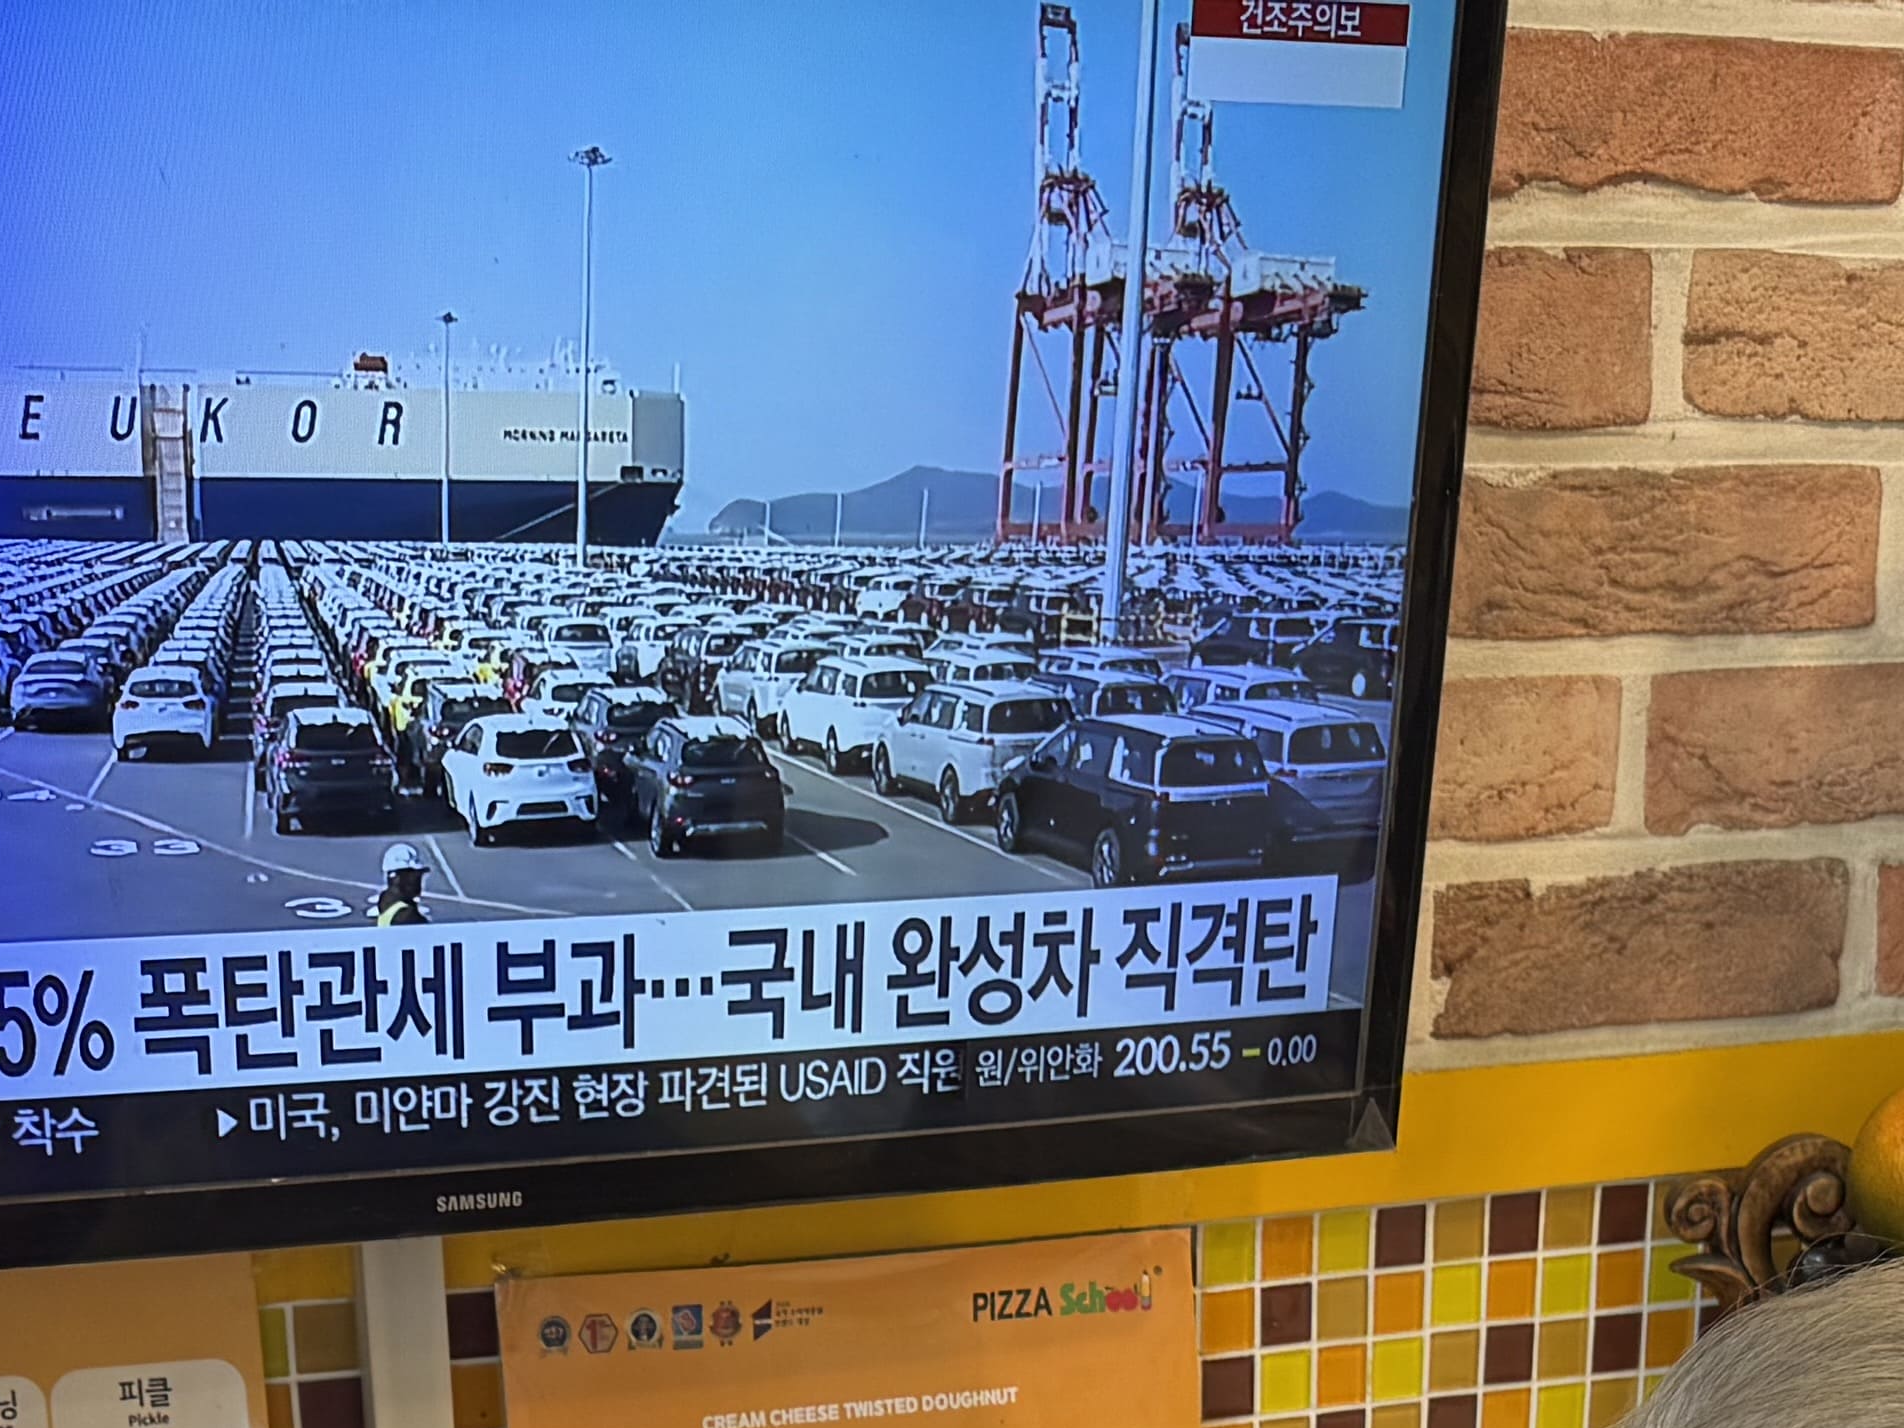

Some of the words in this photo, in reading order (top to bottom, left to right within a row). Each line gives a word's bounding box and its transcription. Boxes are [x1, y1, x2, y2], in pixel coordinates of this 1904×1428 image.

[1240, 0, 1361, 39] 건조주의보
[134, 942, 465, 1075] 폭탄관세
[887, 907, 1100, 1029] 완성차
[1116, 894, 1318, 1012] 직격탄
[976, 1042, 1102, 1088] 원/위안화
[1115, 1031, 1231, 1078] 200.55
[1267, 1034, 1317, 1067] 0.00
[250, 1093, 340, 1141] 미국,
[356, 1084, 473, 1134] 미얀마
[485, 1076, 561, 1127] 강진
[574, 1070, 649, 1119] 현장
[659, 1061, 767, 1113] 파견된
[781, 1057, 886, 1101] USAID
[13, 1107, 99, 1155] 착수
[436, 1191, 522, 1213] SAMSUNG
[972, 1288, 1052, 1322] PIZZA
[1059, 1269, 1153, 1317] School
[118, 1376, 172, 1407] 피클
[770, 1404, 838, 1427] CHEESE
[843, 1396, 917, 1420] TWISTED
[922, 1386, 1017, 1412] DOUGHNUT
[129, 1412, 169, 1427] Pickle
